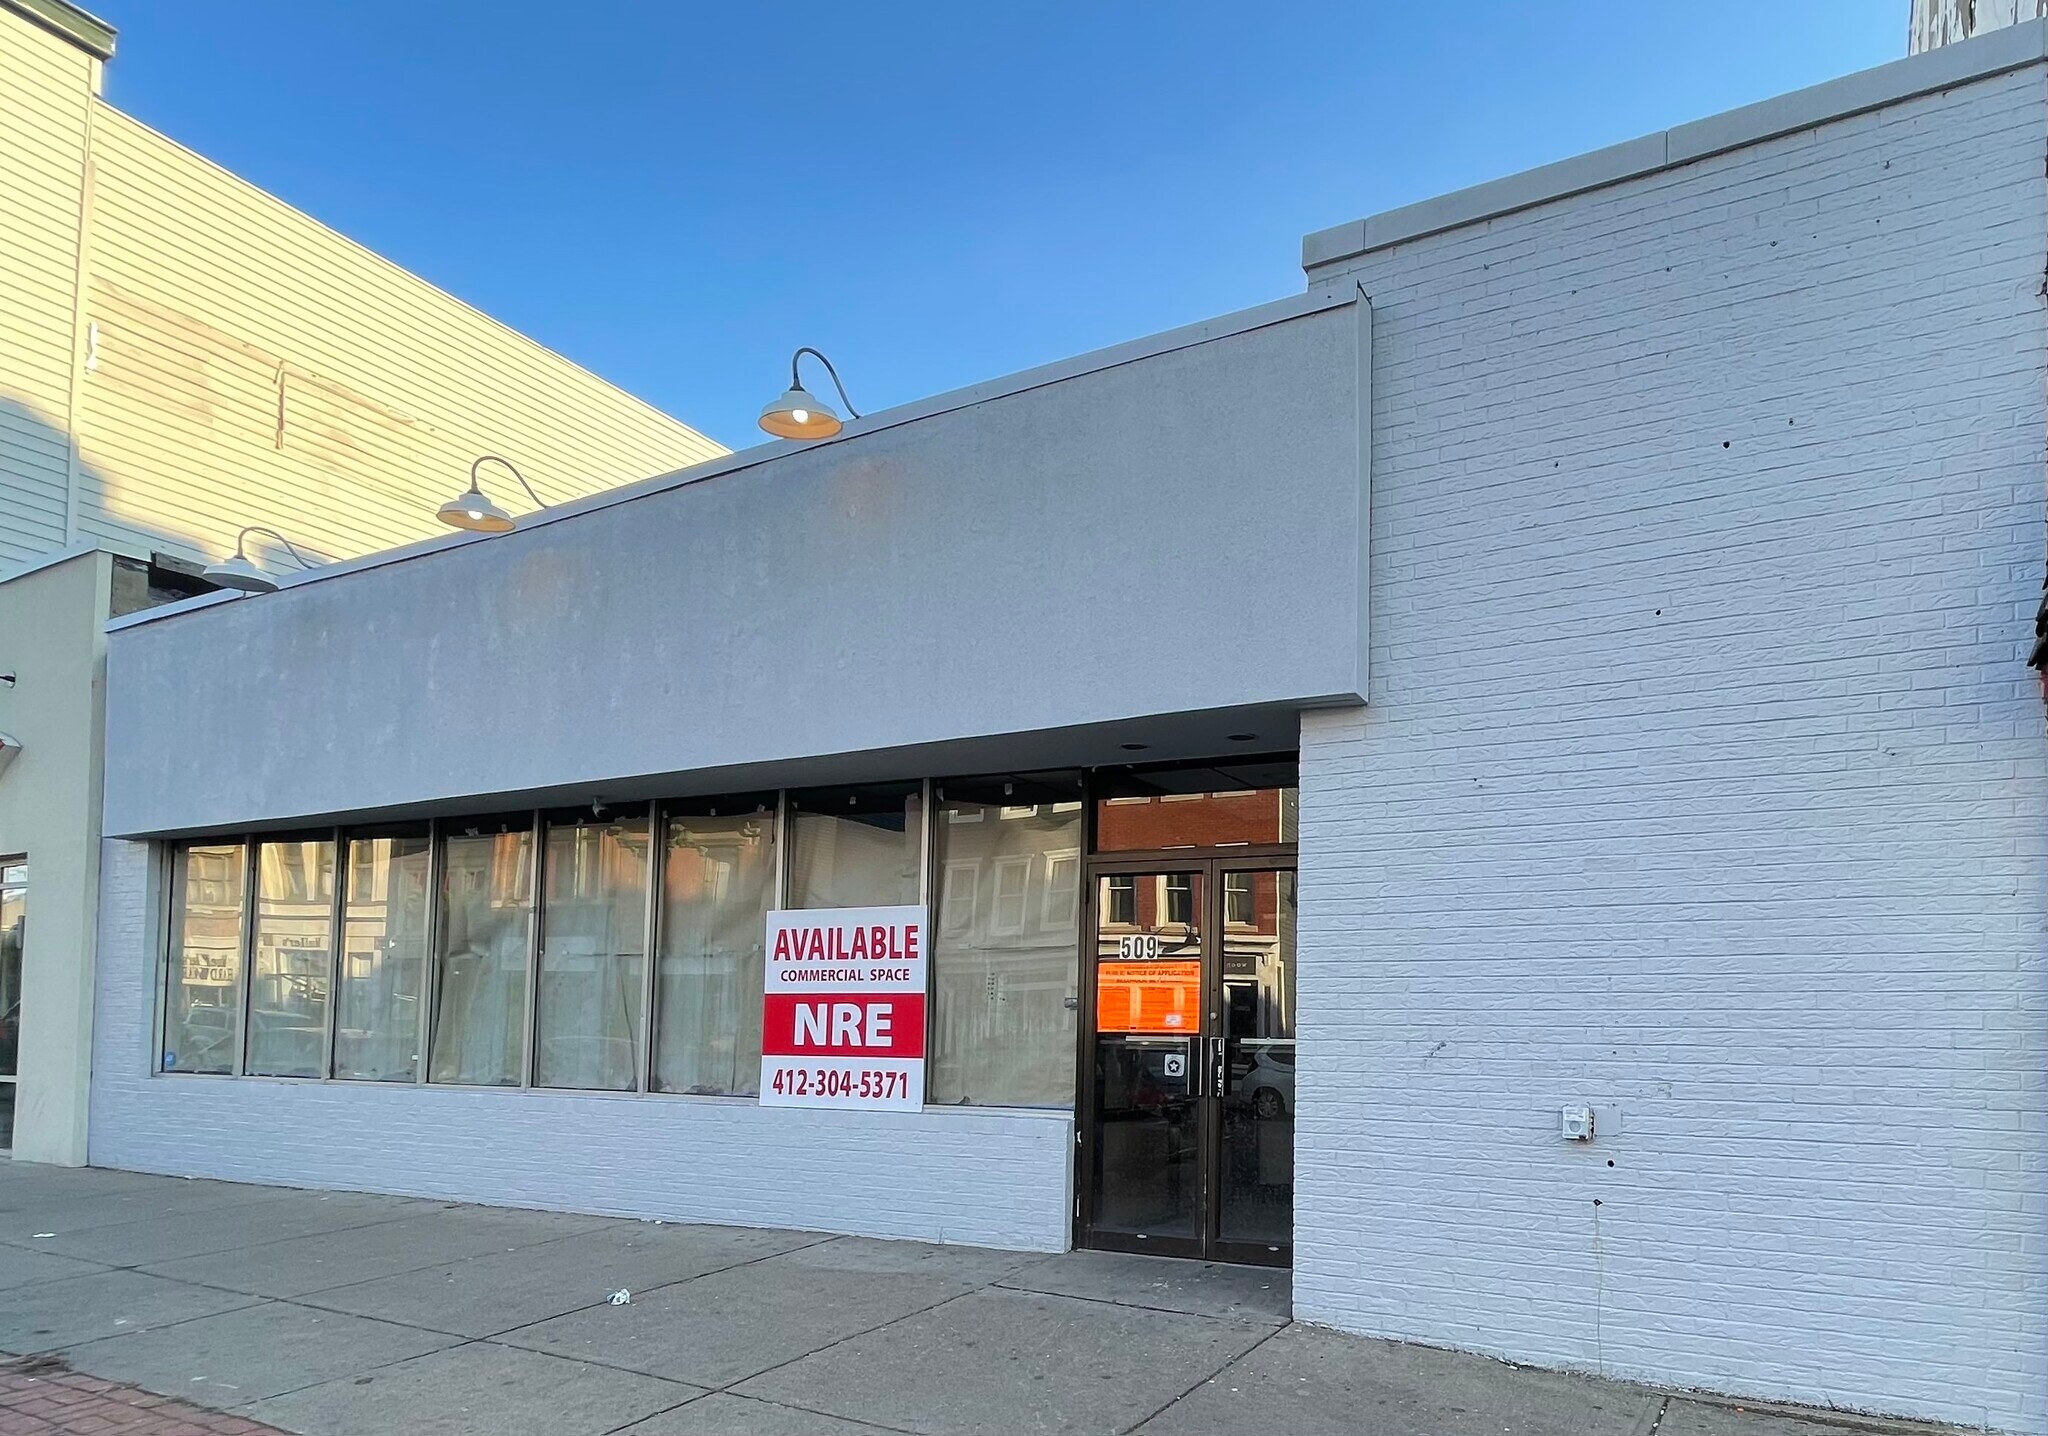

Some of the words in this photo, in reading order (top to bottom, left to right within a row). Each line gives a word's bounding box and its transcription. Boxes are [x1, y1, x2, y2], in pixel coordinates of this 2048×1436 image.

[773, 925, 919, 961] AVAILABLE
[1121, 936, 1157, 959] 509
[780, 969, 864, 982] COMMERCIAL
[870, 968, 910, 981] SPACE
[793, 1003, 893, 1047] NRE
[772, 1069, 908, 1099] 412-304-5371
